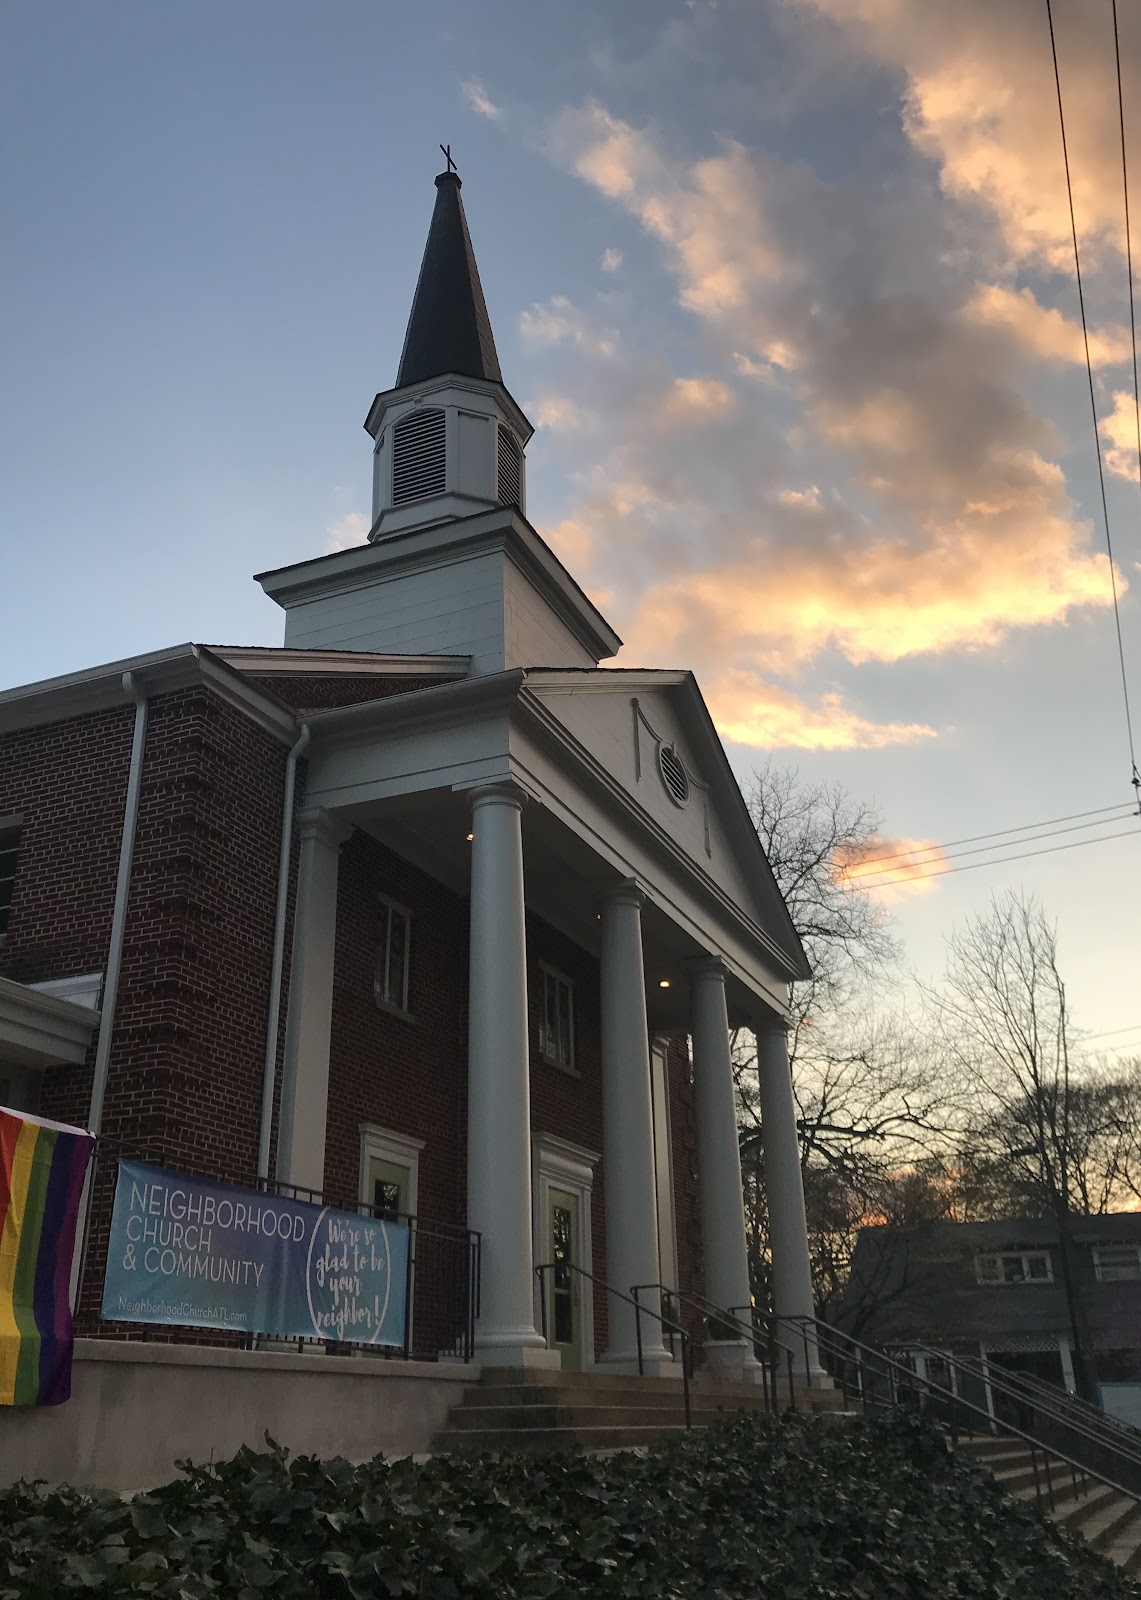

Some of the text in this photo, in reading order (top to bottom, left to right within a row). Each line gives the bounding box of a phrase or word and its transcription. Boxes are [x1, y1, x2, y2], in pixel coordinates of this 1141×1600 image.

[130, 1181, 305, 1243] NEIGHBORHOOD
[126, 1214, 212, 1252] CHURCH
[327, 1218, 377, 1245] We're so
[122, 1243, 264, 1287] & COMMUNITY
[315, 1243, 385, 1288] glad to be
[117, 1296, 248, 1323] NeighborhoodChurchATL.com
[329, 1275, 362, 1306] your
